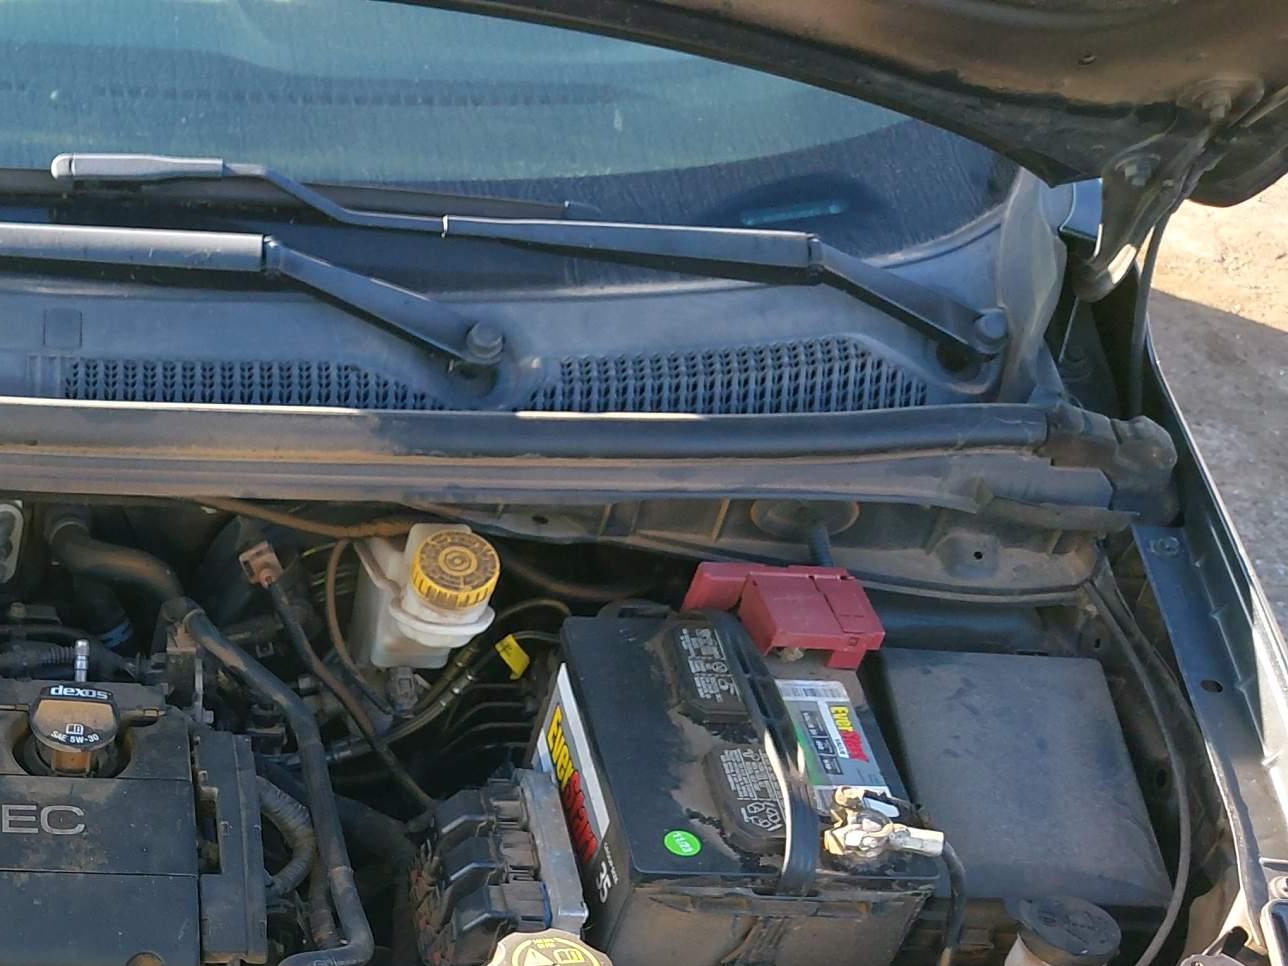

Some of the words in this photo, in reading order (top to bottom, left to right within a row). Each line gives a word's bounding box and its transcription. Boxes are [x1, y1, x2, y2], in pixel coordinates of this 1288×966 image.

[50, 685, 108, 700] dexos
[51, 730, 66, 742] SAE
[69, 733, 100, 744] 5W-30
